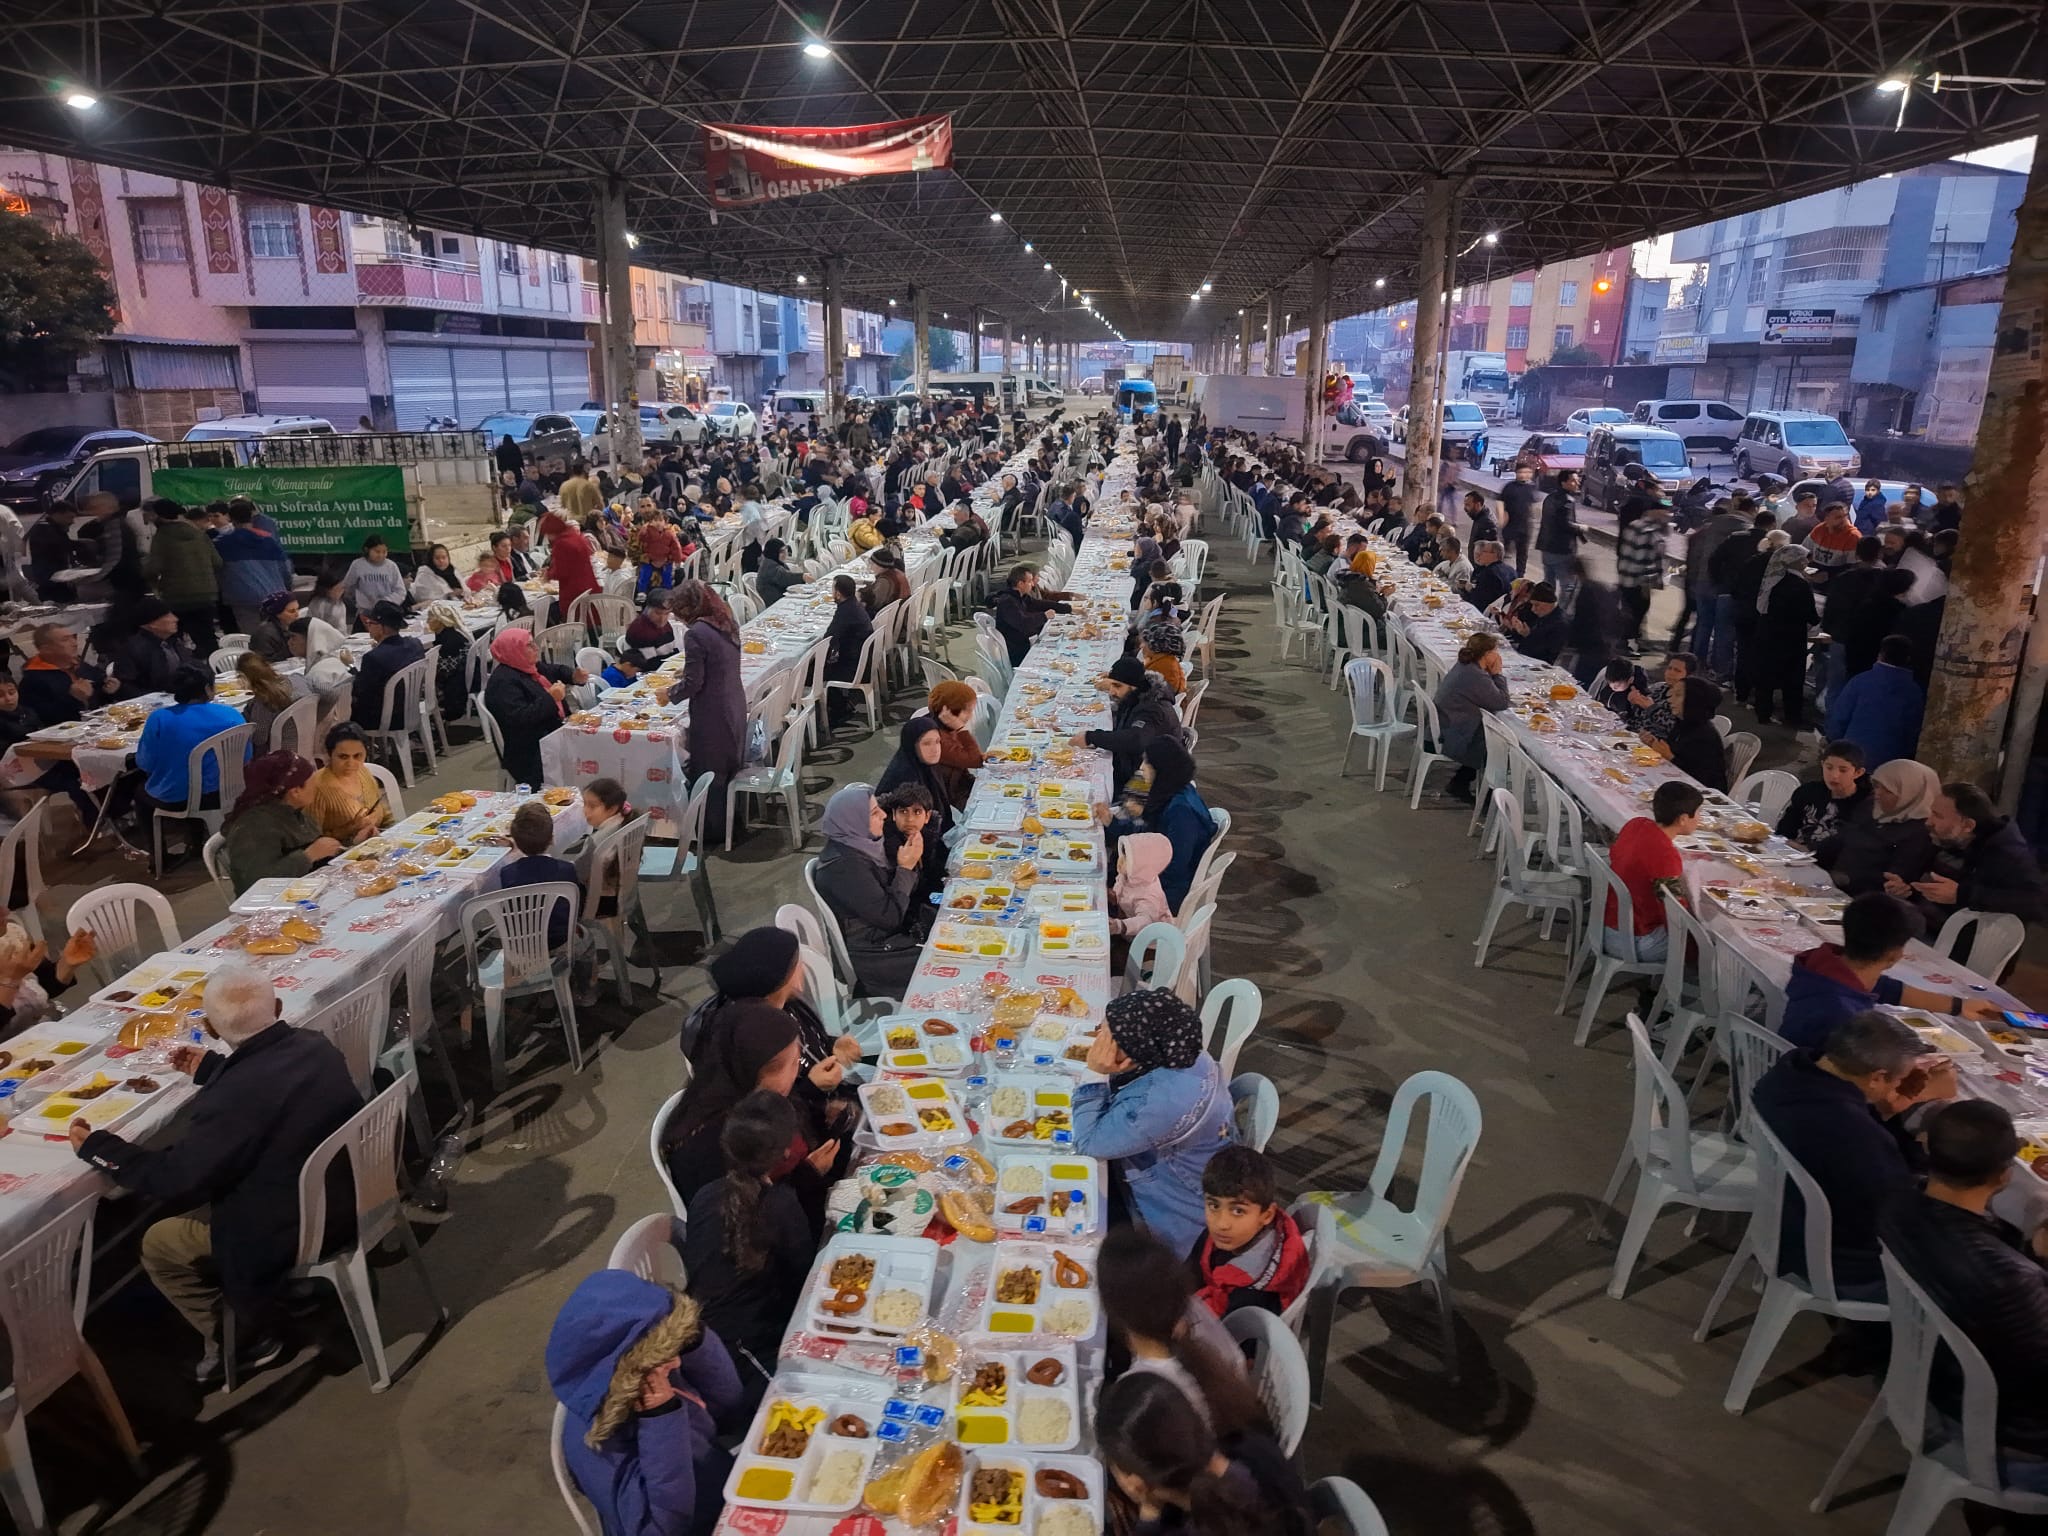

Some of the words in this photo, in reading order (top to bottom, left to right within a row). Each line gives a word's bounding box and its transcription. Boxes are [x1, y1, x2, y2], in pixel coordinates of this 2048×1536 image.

[872, 122, 946, 148] SPOT
[767, 180, 812, 199] 0545
[1768, 316, 1788, 324] OTO
[281, 500, 329, 513] Sofrada
[332, 500, 361, 514] Aynı
[363, 499, 394, 512] Dua:
[343, 515, 403, 528] Adana'da
[279, 532, 345, 547] uluşmaları
